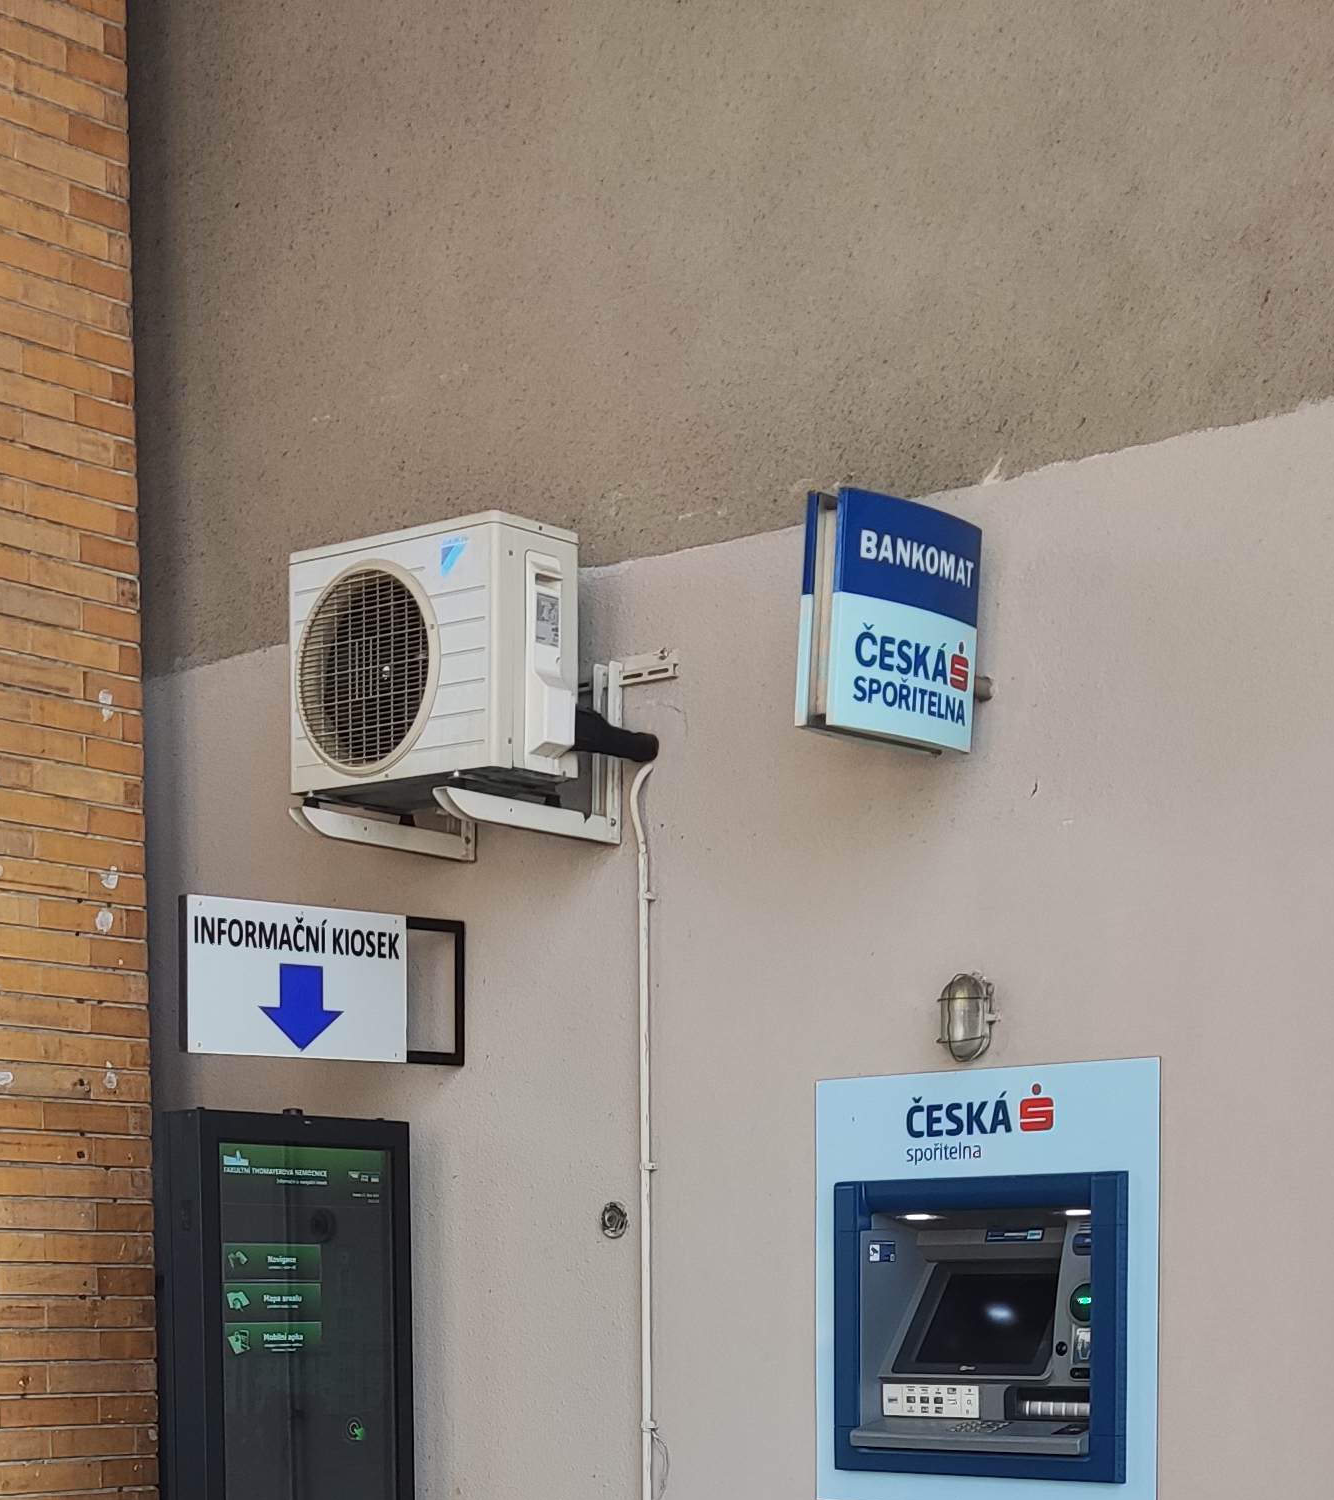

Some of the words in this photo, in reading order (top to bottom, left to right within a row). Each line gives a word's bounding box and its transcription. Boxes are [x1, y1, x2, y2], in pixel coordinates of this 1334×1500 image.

[859, 528, 976, 588] BANKOMAT
[854, 622, 948, 686] ČESKÁ
[852, 675, 966, 727] SPOŘITELNA
[193, 914, 327, 954] INFORMAČNÍ
[331, 926, 400, 960] KIOSEK
[905, 1090, 1012, 1139] ČESKÁ
[905, 1141, 982, 1165] spořitelna
